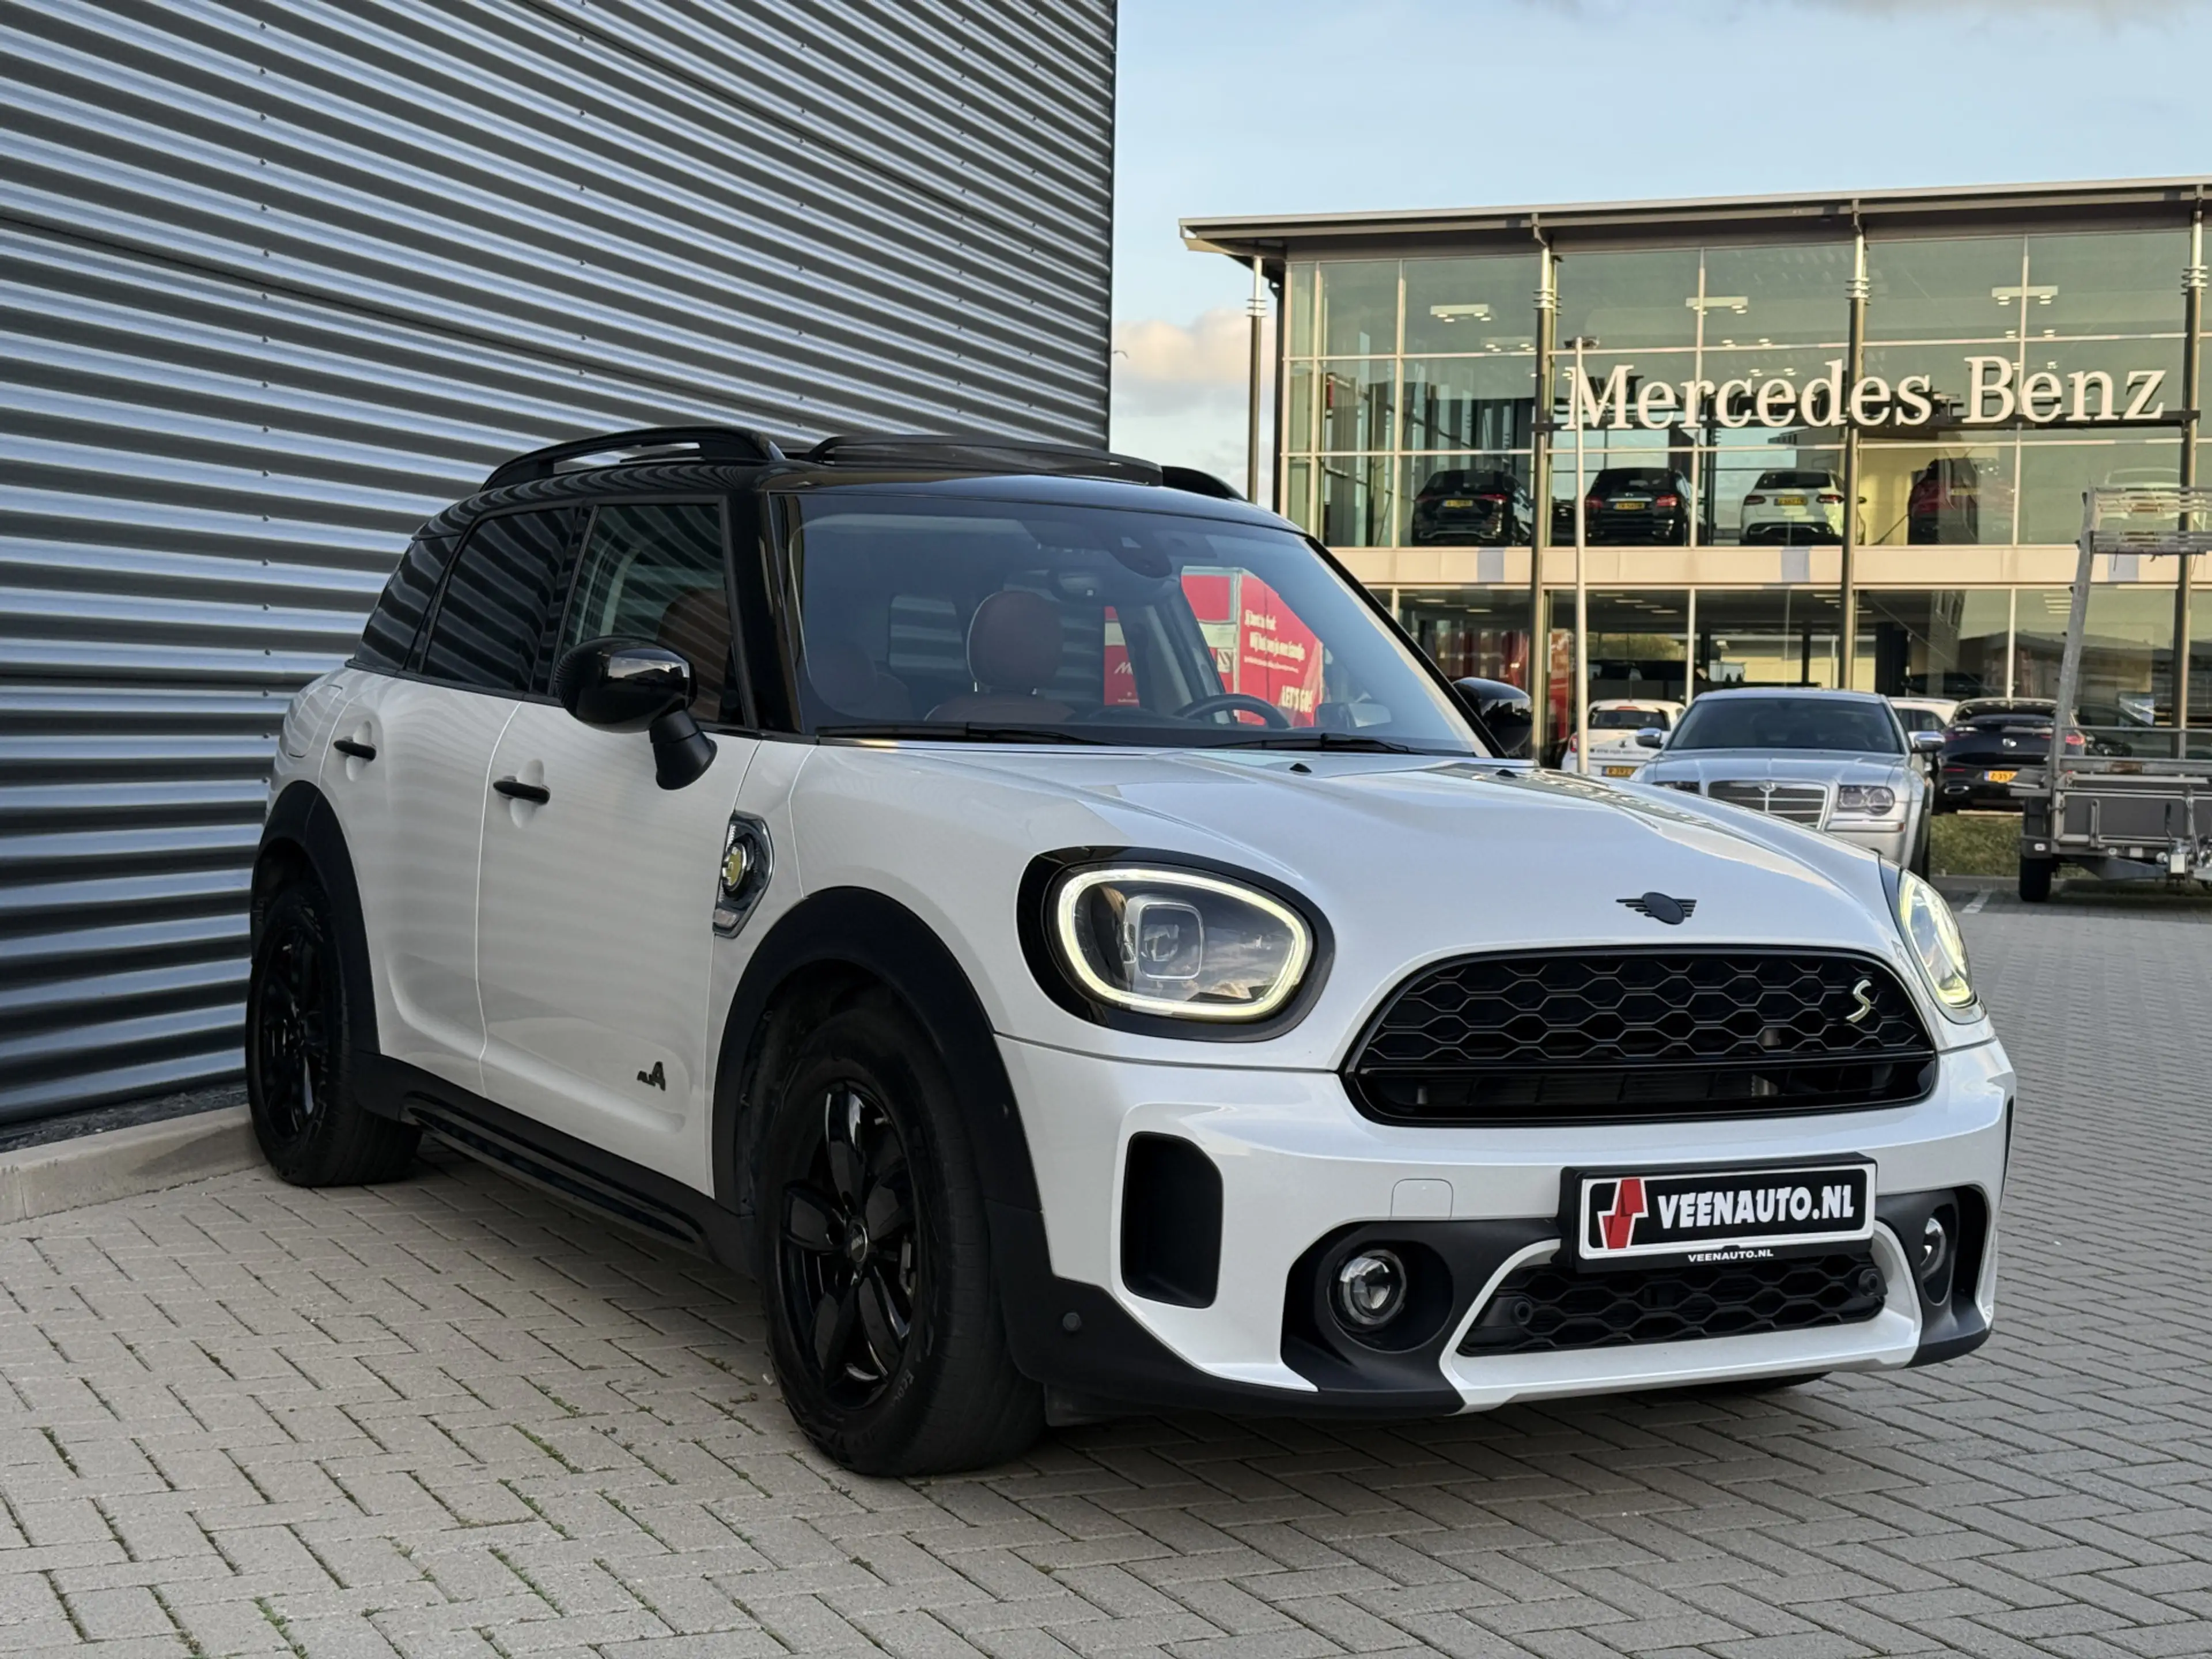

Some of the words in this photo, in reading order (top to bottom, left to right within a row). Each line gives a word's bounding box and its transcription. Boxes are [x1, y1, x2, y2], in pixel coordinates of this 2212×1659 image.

[1560, 358, 1931, 430] Mercedes
[1962, 355, 2166, 423] Benz
[1657, 1184, 1854, 1229] VEENAUTO.NL
[1687, 1249, 1774, 1262] VEENAUTO.NL
